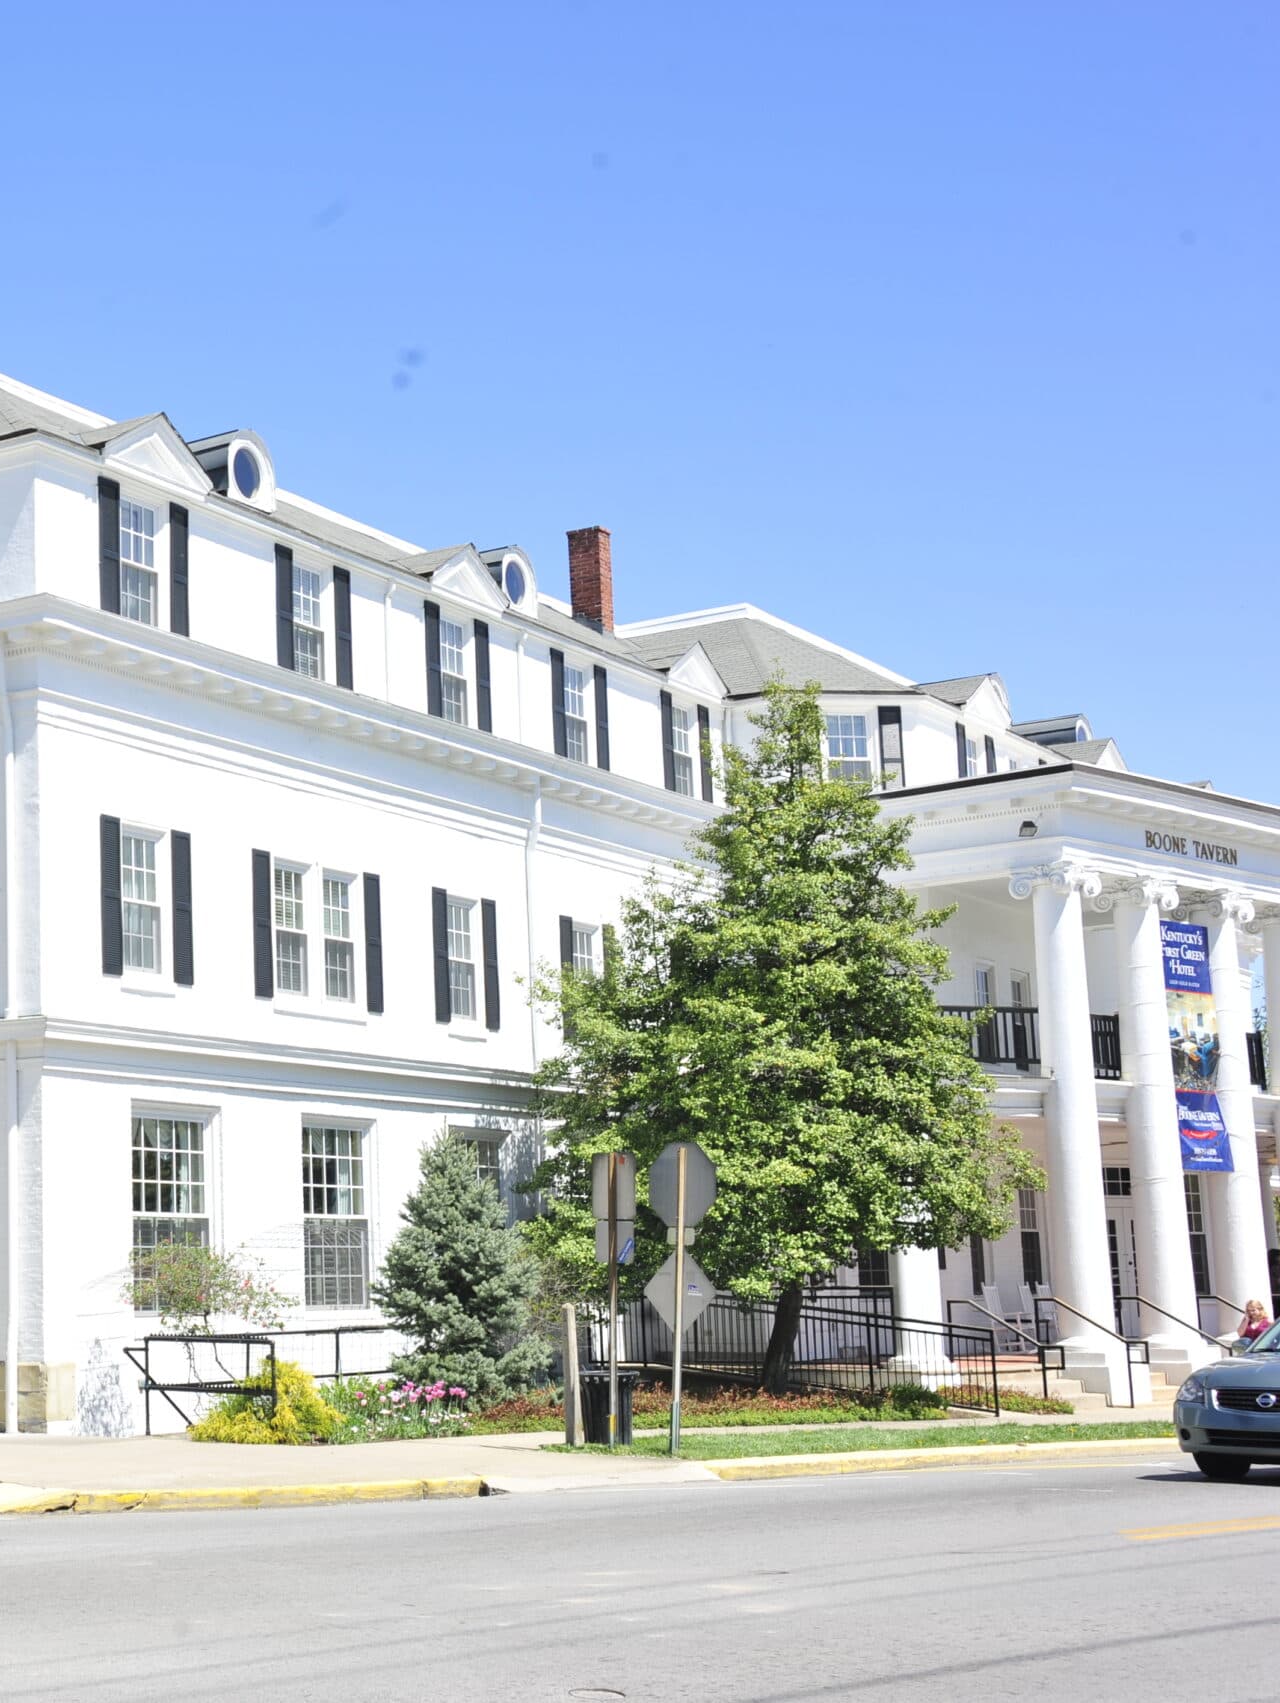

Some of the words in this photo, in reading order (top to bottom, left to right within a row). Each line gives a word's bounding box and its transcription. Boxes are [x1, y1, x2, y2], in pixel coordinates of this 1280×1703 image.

[1145, 830, 1188, 855] BOONE
[1192, 840, 1238, 866] TAVERN
[1160, 925, 1203, 946] KENTUCKY'S
[1180, 944, 1206, 961] GREEN
[1171, 959, 1197, 976] HOTEL
